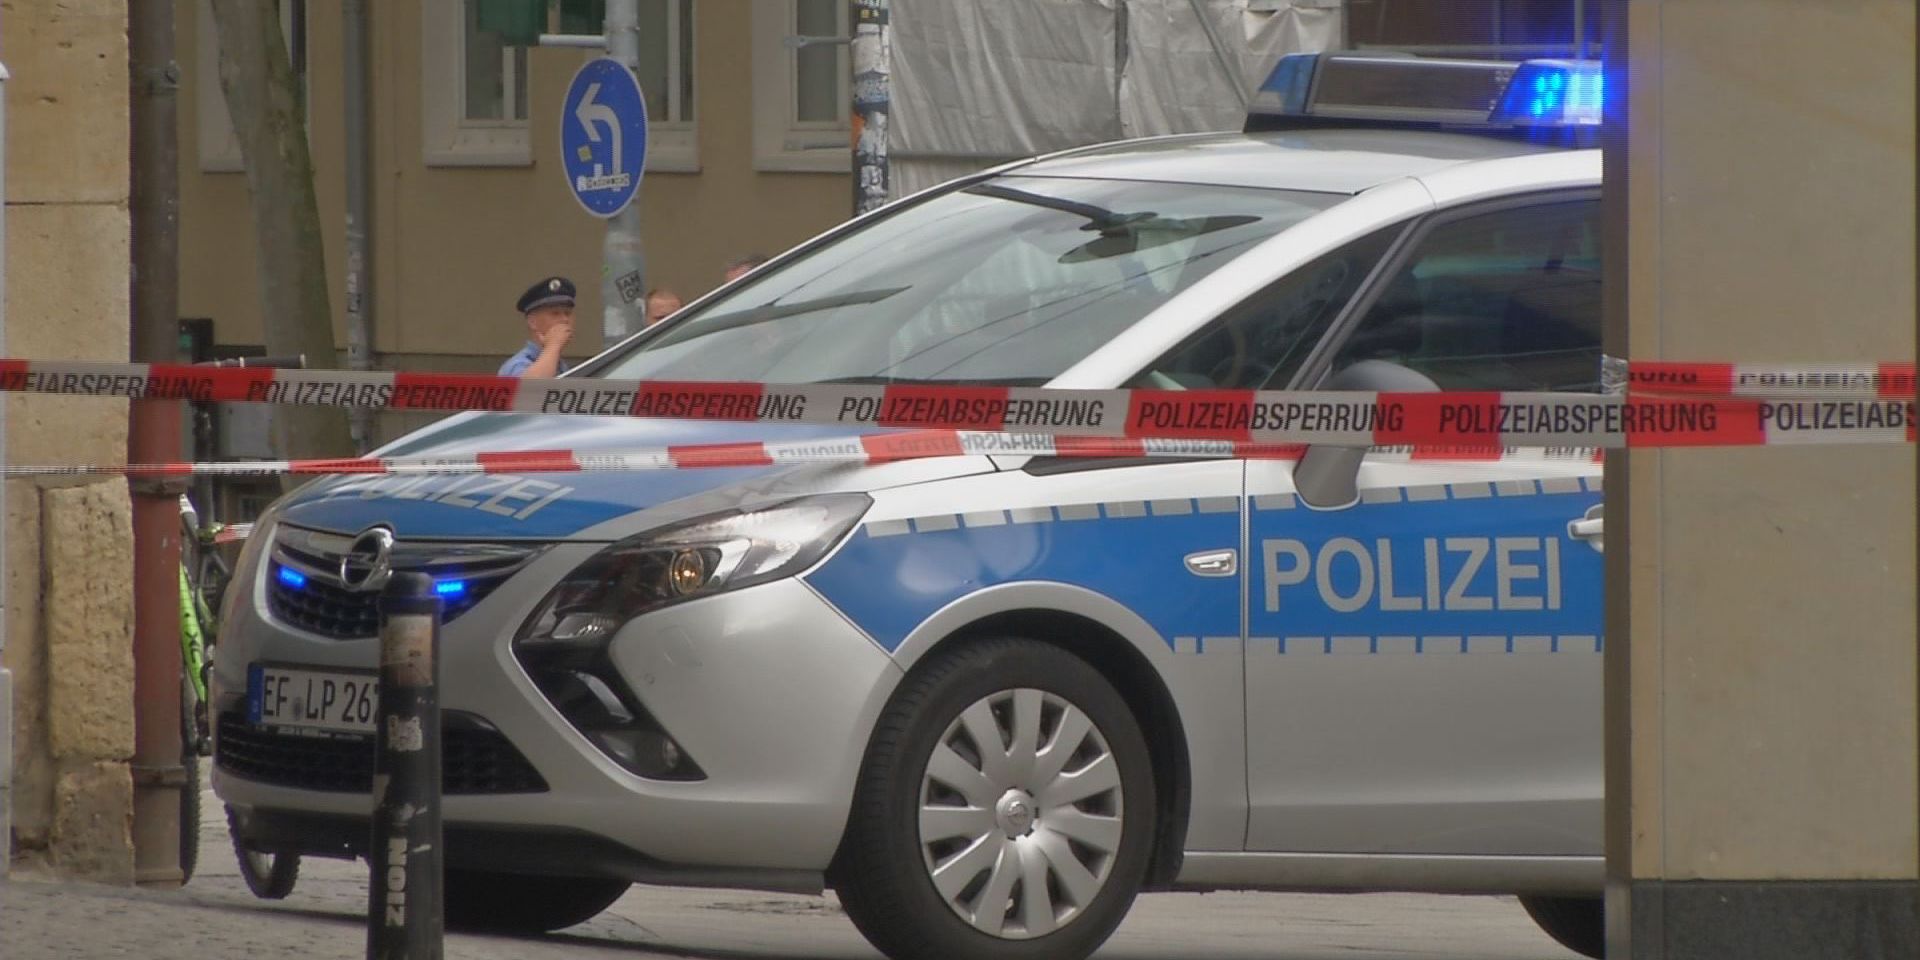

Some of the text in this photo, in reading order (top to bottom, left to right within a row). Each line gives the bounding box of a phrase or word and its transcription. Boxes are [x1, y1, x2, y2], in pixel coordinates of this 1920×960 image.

[247, 381, 511, 411] POLIZEIABSPERRUNG
[542, 390, 806, 420] POLIZEIABSPERRUNG
[838, 397, 1104, 426] POLIZEIABSPERRUNG
[1137, 402, 1404, 432] POLIZEIABSPERRUNG
[1439, 403, 1717, 433] POLIZEIABSPERRUNG
[1262, 537, 1561, 612] POLIZEI
[263, 675, 291, 717] EF
[306, 677, 337, 720] LP
